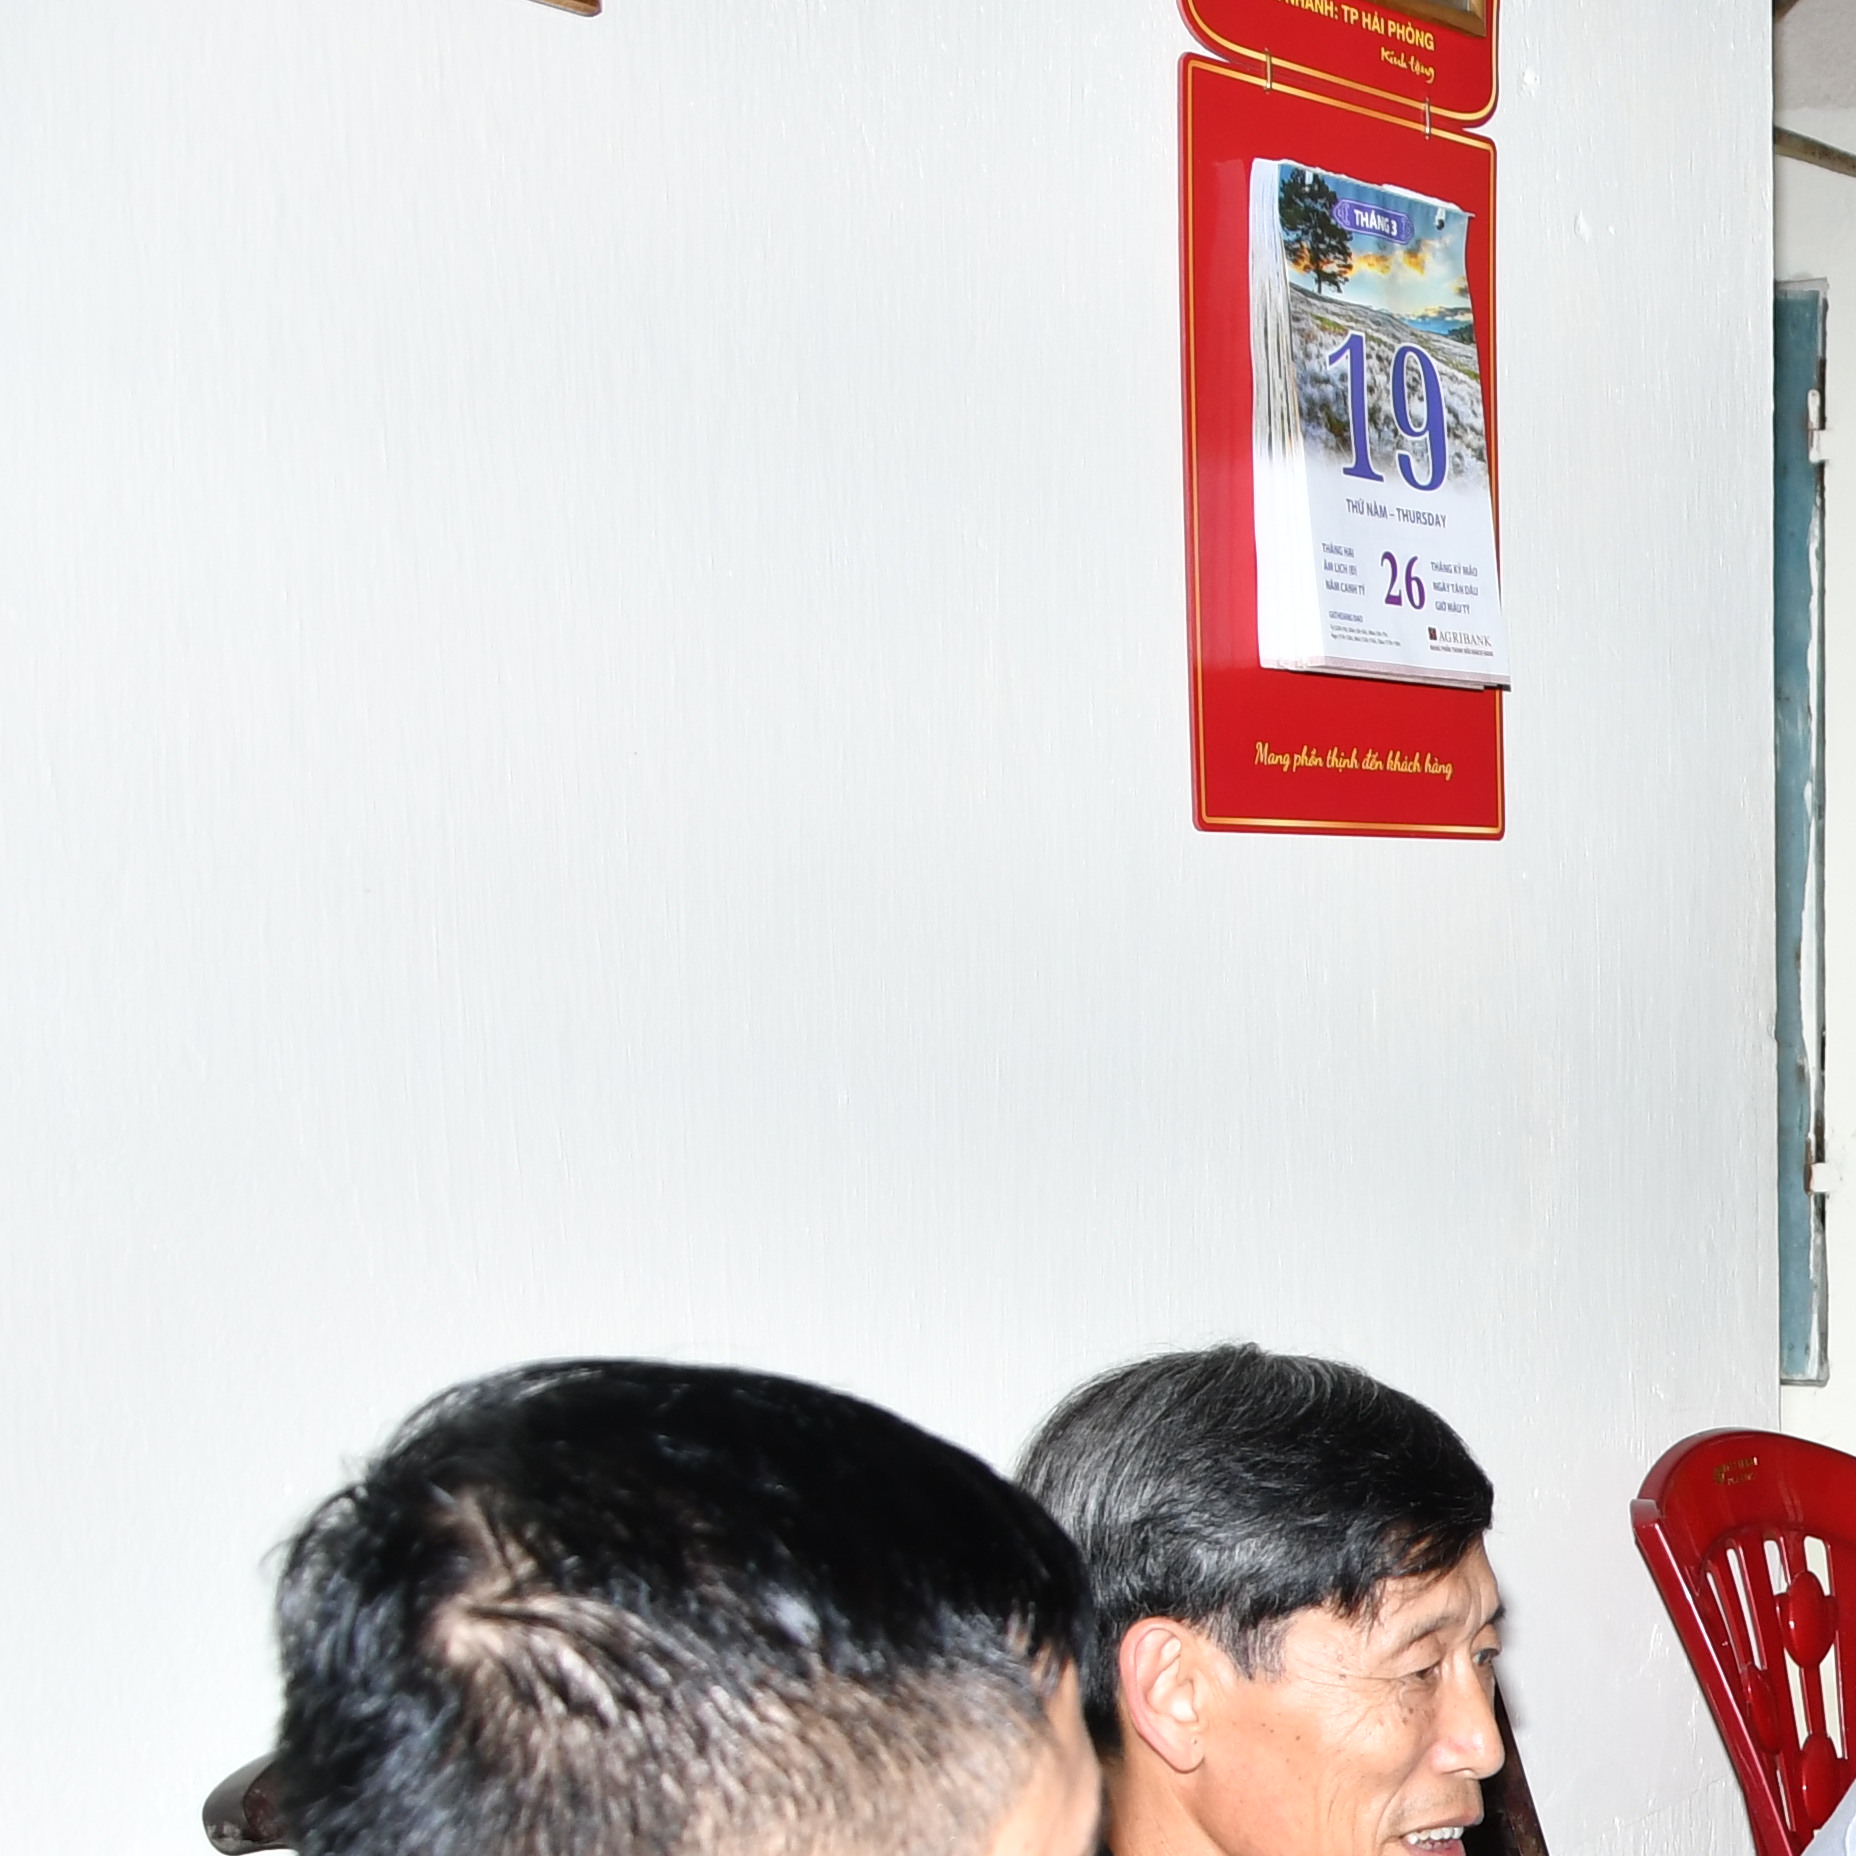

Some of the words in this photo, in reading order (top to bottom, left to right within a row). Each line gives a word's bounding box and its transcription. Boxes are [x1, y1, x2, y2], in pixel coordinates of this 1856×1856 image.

[1341, 4, 1359, 25] TP
[1362, 11, 1385, 35] HẢI
[1388, 21, 1435, 51] PHÒNG
[1353, 208, 1390, 235] THÁNG
[1390, 219, 1398, 237] 3
[1327, 332, 1449, 491] 19
[1345, 498, 1365, 515] THỨ
[1395, 507, 1447, 528] THURSDAY
[1380, 550, 1426, 610] 26
[1438, 630, 1493, 648] AGRIBANK
[1254, 741, 1291, 772] Mang
[1293, 744, 1324, 772] phồn
[1326, 745, 1360, 773] thịnh
[1361, 748, 1384, 771] đến
[1386, 749, 1422, 773] khách
[1424, 752, 1454, 781] hàng
